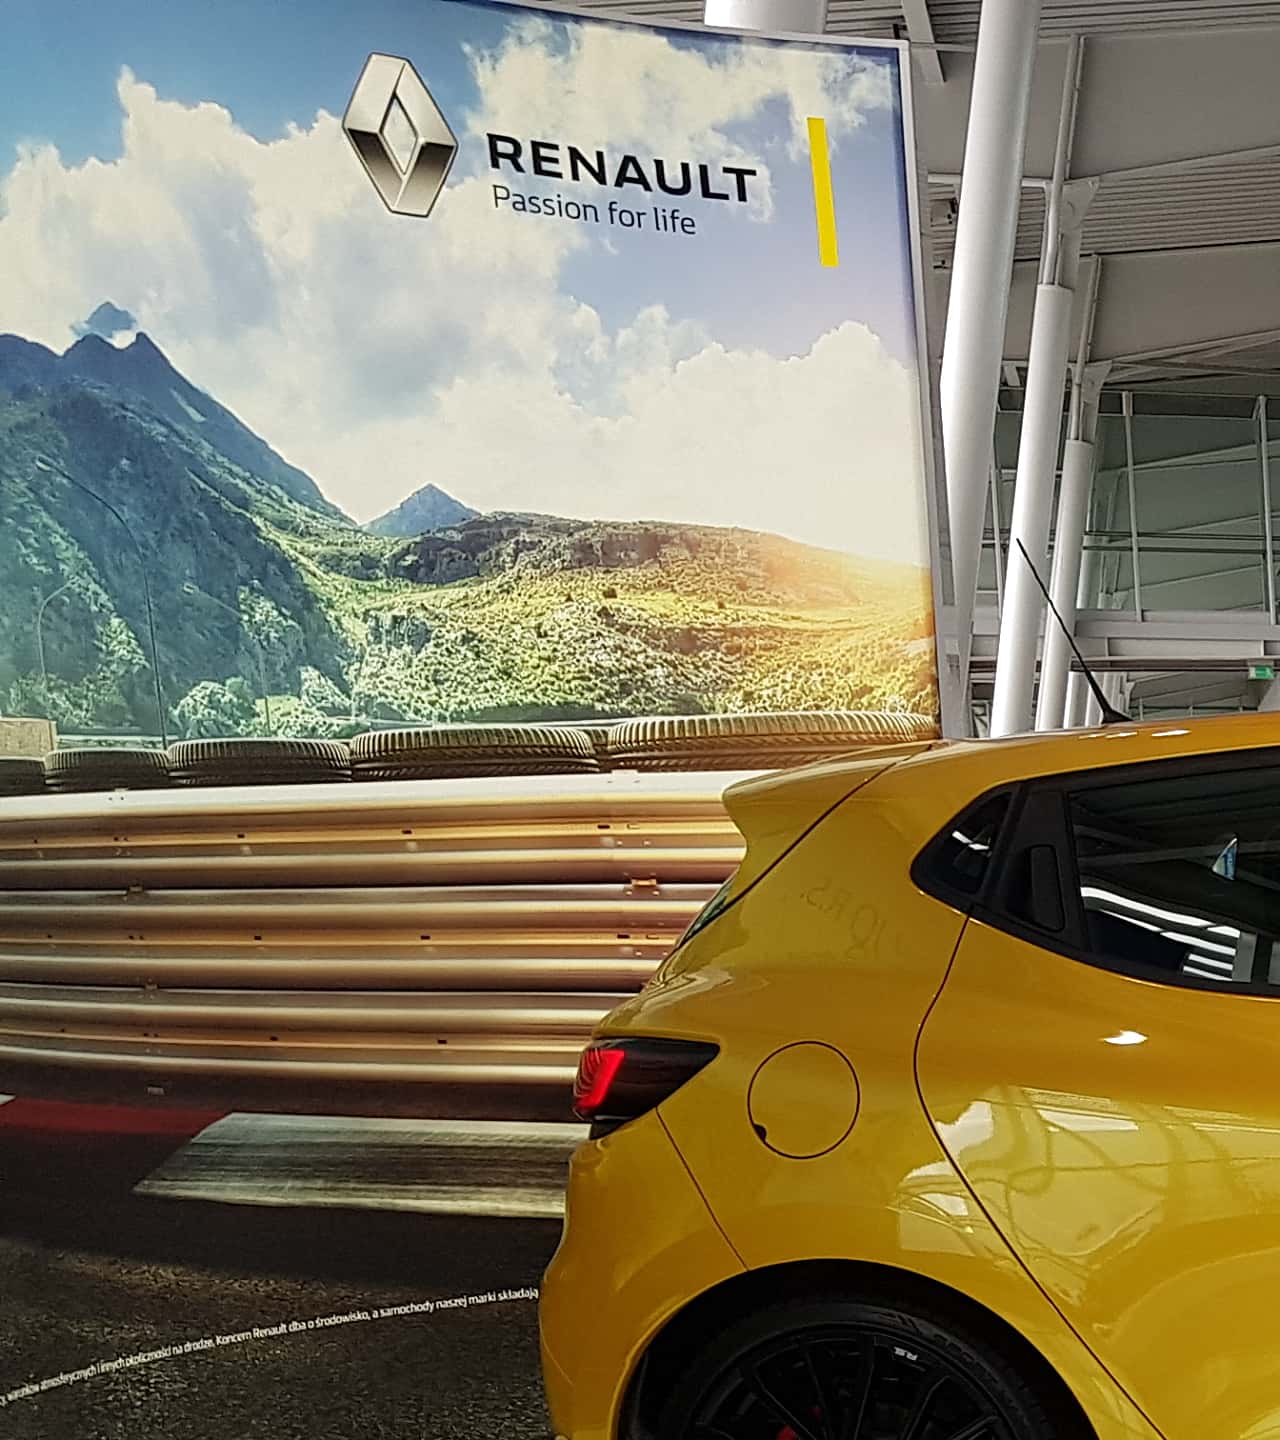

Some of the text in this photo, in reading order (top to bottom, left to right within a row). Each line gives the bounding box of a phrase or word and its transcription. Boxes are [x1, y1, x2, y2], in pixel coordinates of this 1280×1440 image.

[486, 132, 757, 203] RENAULT
[492, 184, 697, 236] Passion for life
[216, 1331, 252, 1346] Koncern
[253, 1322, 288, 1338] Renault
[288, 1320, 307, 1333] dba
[307, 1320, 315, 1329] o
[315, 1310, 371, 1329] środowisko,
[372, 1310, 379, 1319] a
[380, 1300, 435, 1318] samochody
[435, 1295, 467, 1309] naszej
[468, 1290, 497, 1305] marki
[497, 1286, 539, 1301] składają
